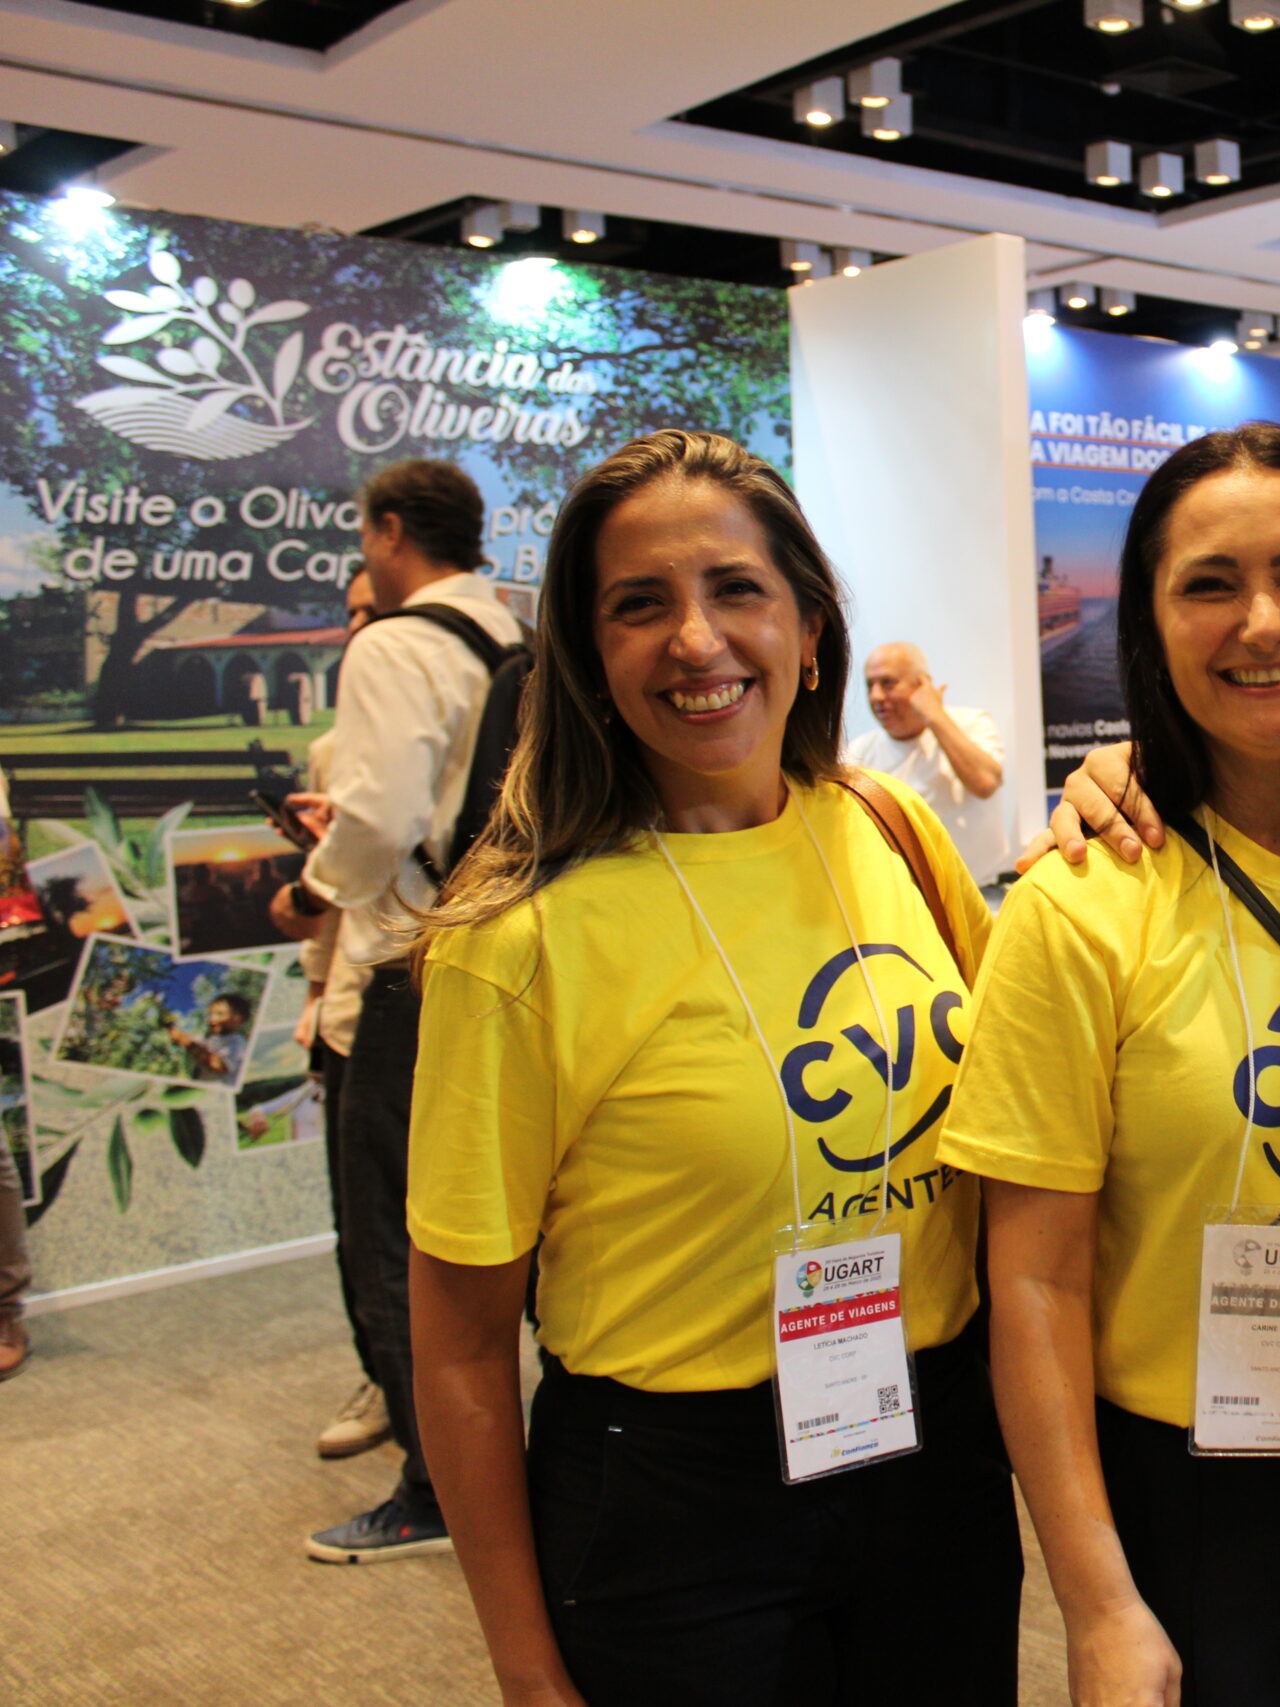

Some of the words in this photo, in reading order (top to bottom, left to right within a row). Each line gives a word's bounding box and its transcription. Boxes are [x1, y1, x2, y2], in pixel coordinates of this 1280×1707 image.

[306, 322, 544, 394] Estância
[547, 361, 597, 394] das
[337, 381, 591, 454] Oliveiras
[1048, 411, 1084, 435] FOI
[1086, 411, 1130, 439] TÃO
[1131, 415, 1184, 444] FÁCIL
[1047, 440, 1129, 468] VIAGEM
[37, 478, 176, 526] Visite
[65, 536, 138, 580] de
[152, 550, 252, 581] uma
[780, 990, 966, 1123] CVC
[824, 1256, 885, 1283] UGART
[780, 1315, 826, 1334] AGENTE
[830, 1311, 845, 1323] DE
[848, 1300, 897, 1319] VIAGENS
[1212, 1296, 1264, 1309] AGENTE
